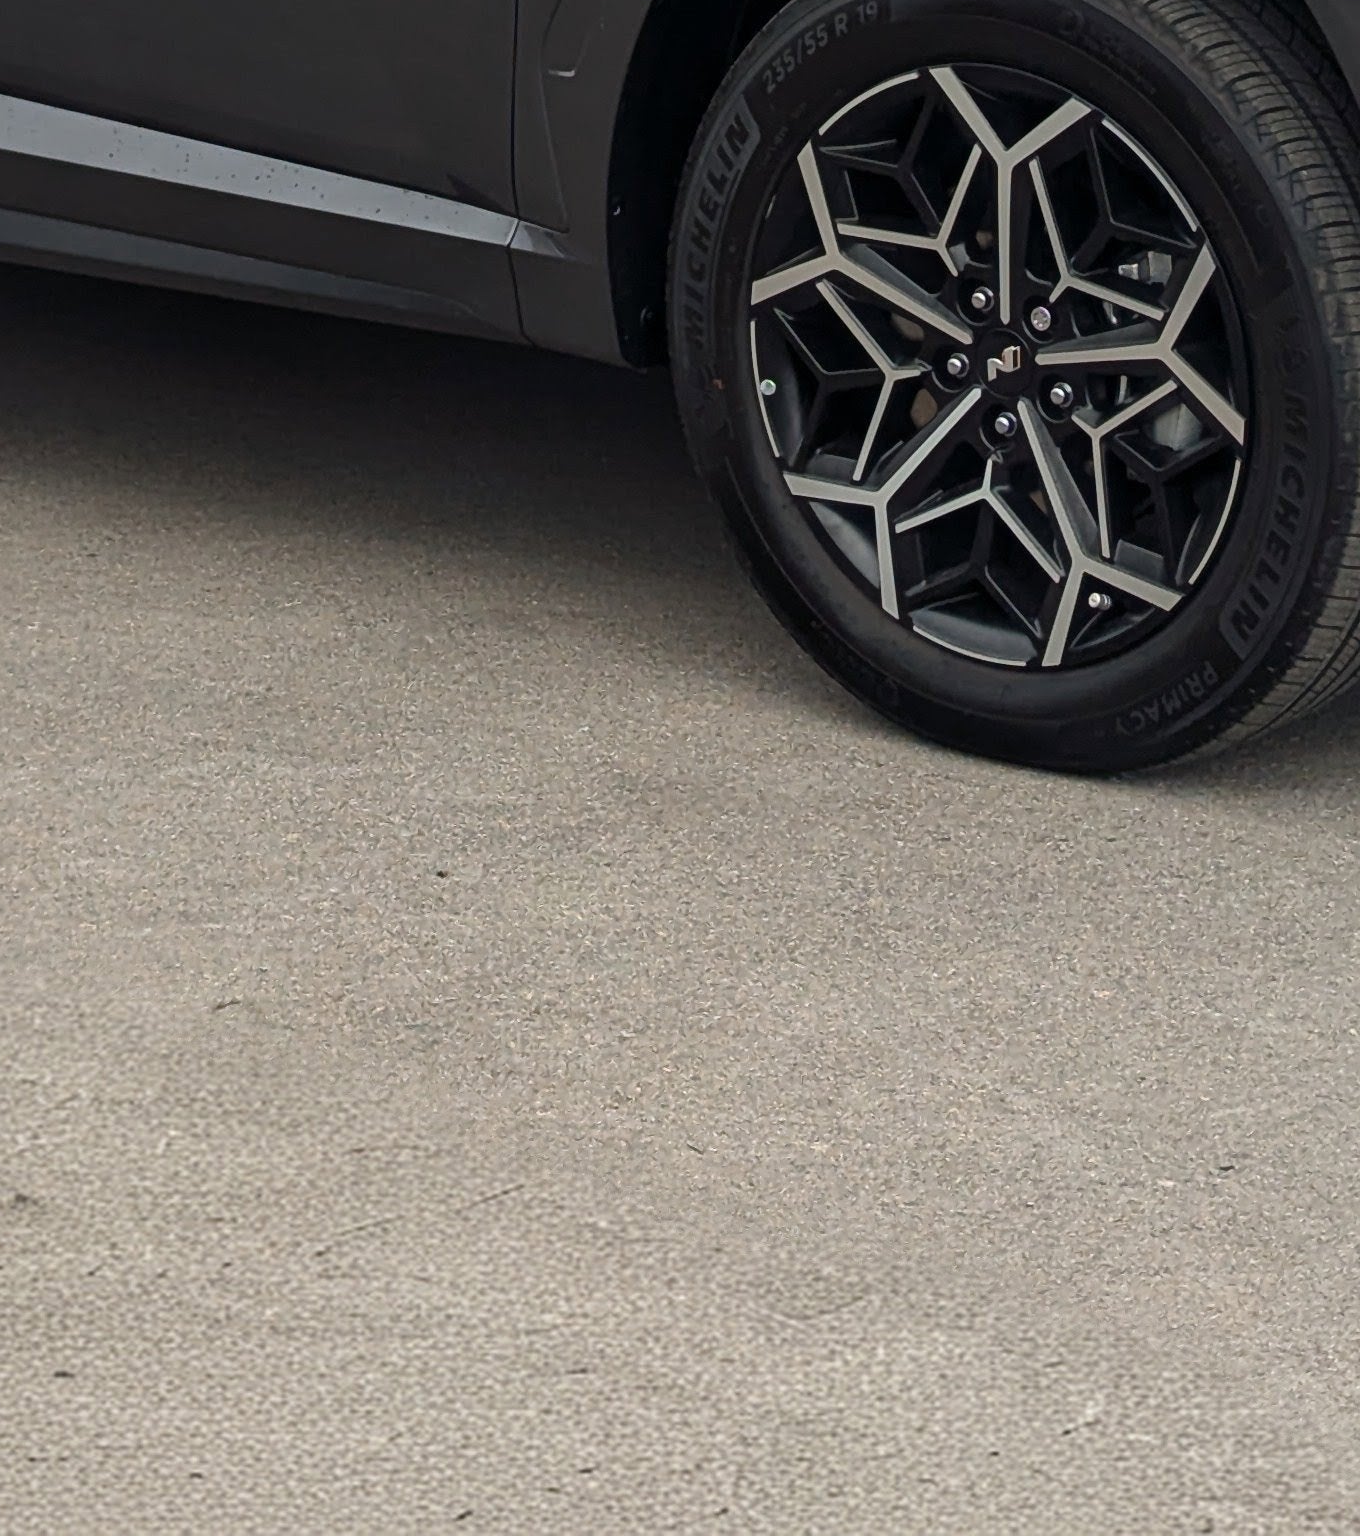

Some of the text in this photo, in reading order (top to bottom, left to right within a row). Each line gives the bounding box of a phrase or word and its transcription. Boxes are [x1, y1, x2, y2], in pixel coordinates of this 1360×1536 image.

[762, 0, 878, 95] 235/55 R 19
[682, 112, 750, 351] MICHELIN
[1230, 387, 1311, 642] MICHELIN
[1116, 660, 1219, 737] PRIMACY
